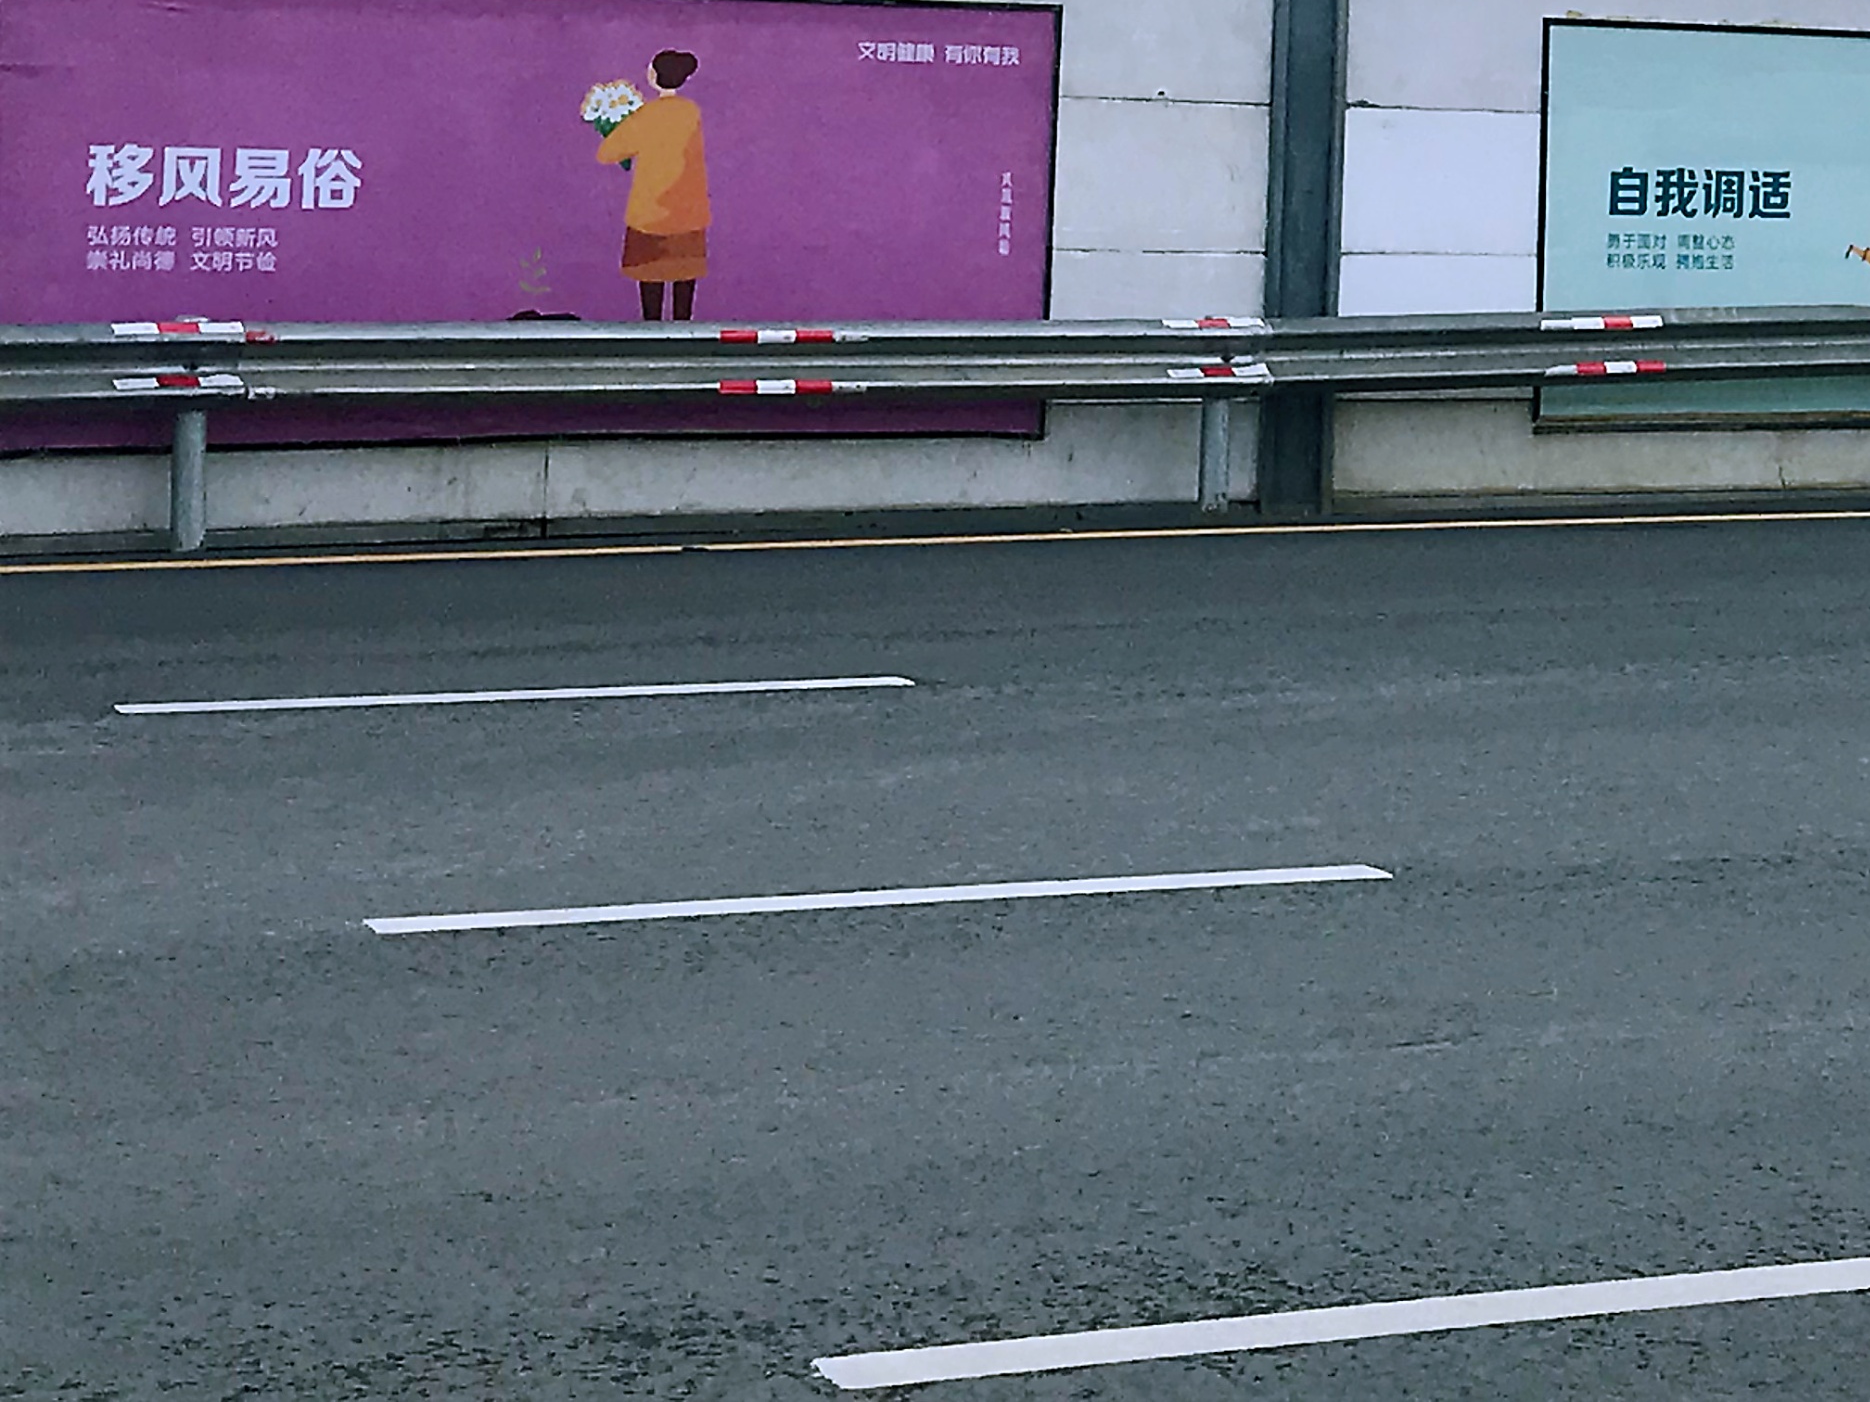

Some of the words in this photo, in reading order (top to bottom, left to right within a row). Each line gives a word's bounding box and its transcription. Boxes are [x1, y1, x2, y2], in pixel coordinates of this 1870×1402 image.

[858, 41, 935, 63] 文明健康
[944, 44, 1021, 66] 有你有我
[86, 143, 363, 210] 移风易俗
[1608, 166, 1792, 219] 自我调适
[87, 225, 177, 247] 弘扬传统
[190, 227, 279, 248] 引领新风
[190, 251, 277, 272] 文明节俭
[1606, 253, 1666, 270] 积极乐观
